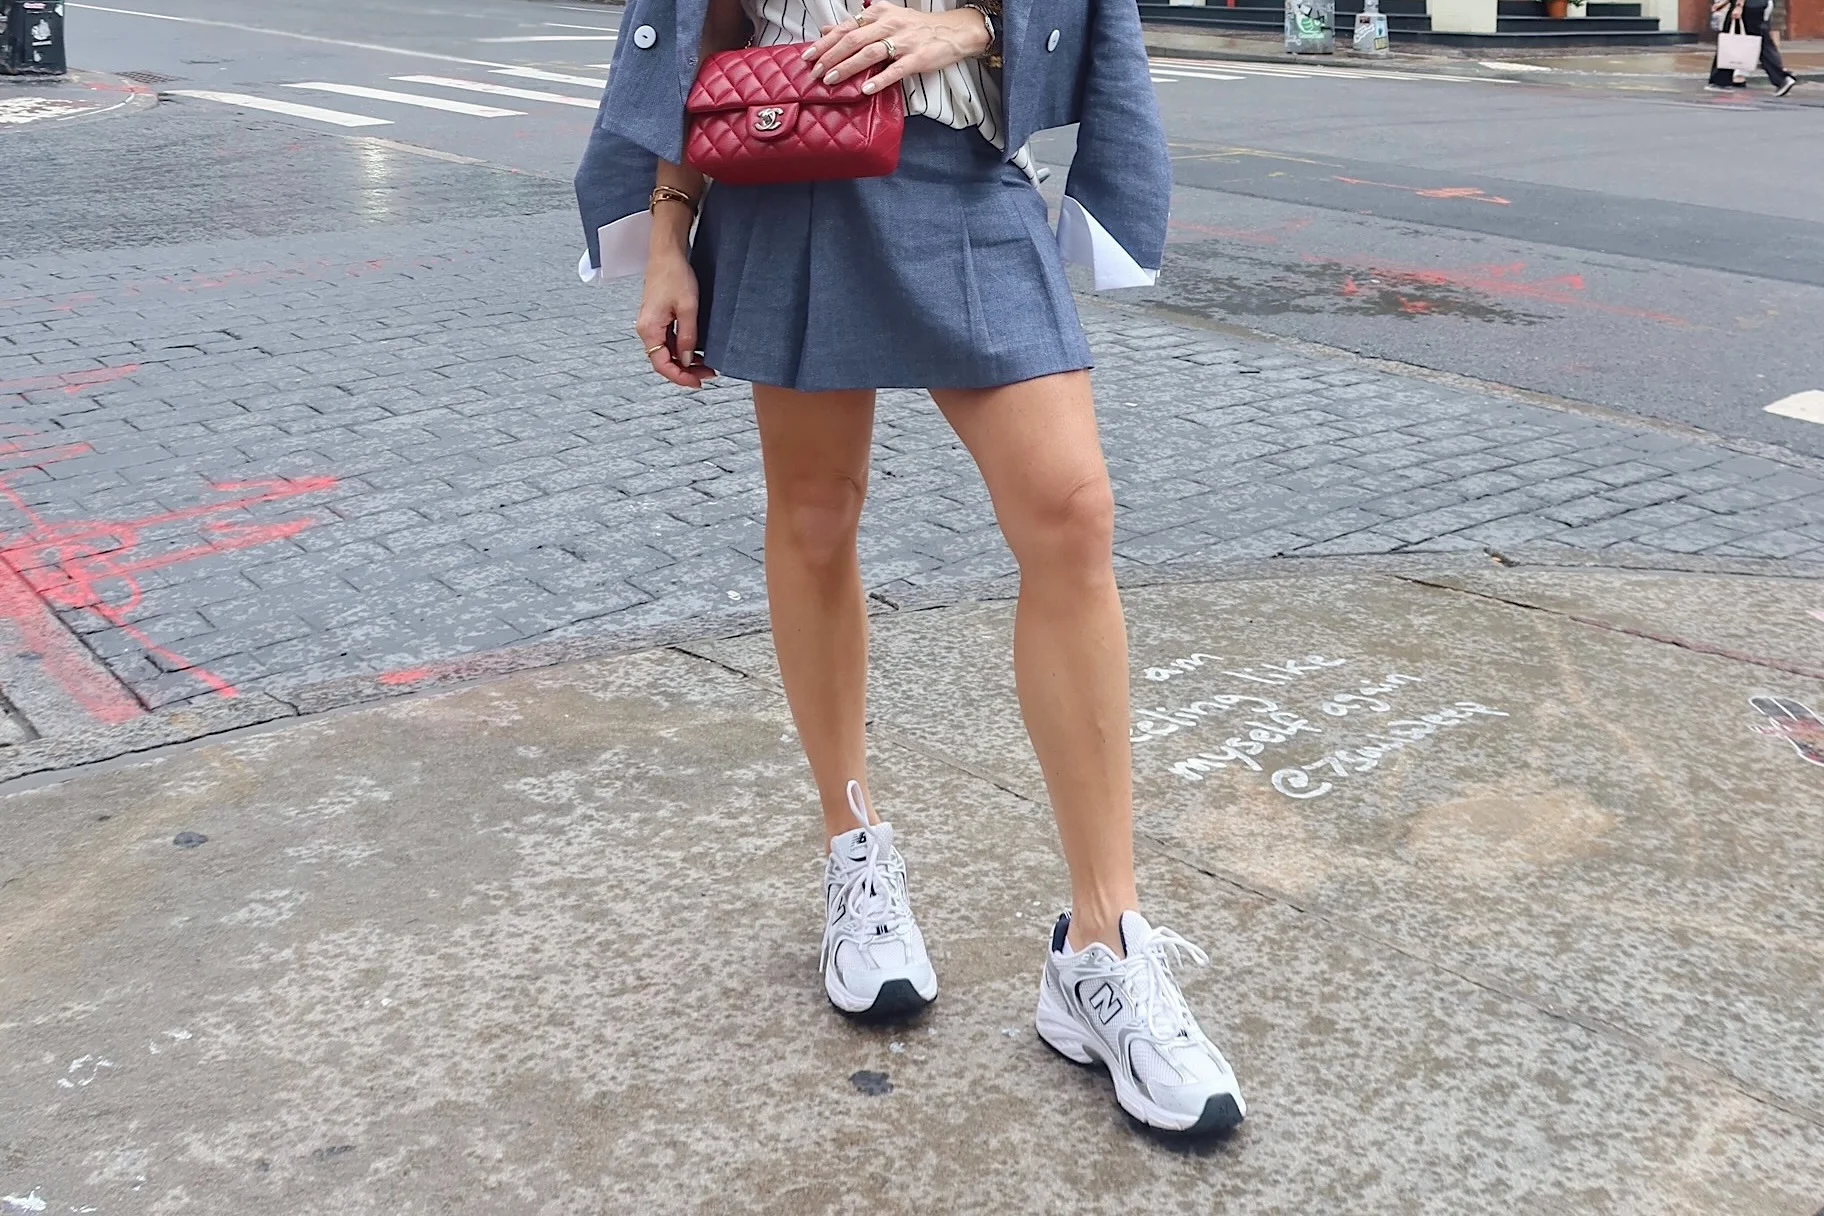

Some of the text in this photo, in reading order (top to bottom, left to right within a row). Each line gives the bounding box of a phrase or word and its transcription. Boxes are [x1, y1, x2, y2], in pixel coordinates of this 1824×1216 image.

[1143, 653, 1224, 682] am
[1222, 654, 1346, 685] like
[1167, 673, 1426, 781] myself again
